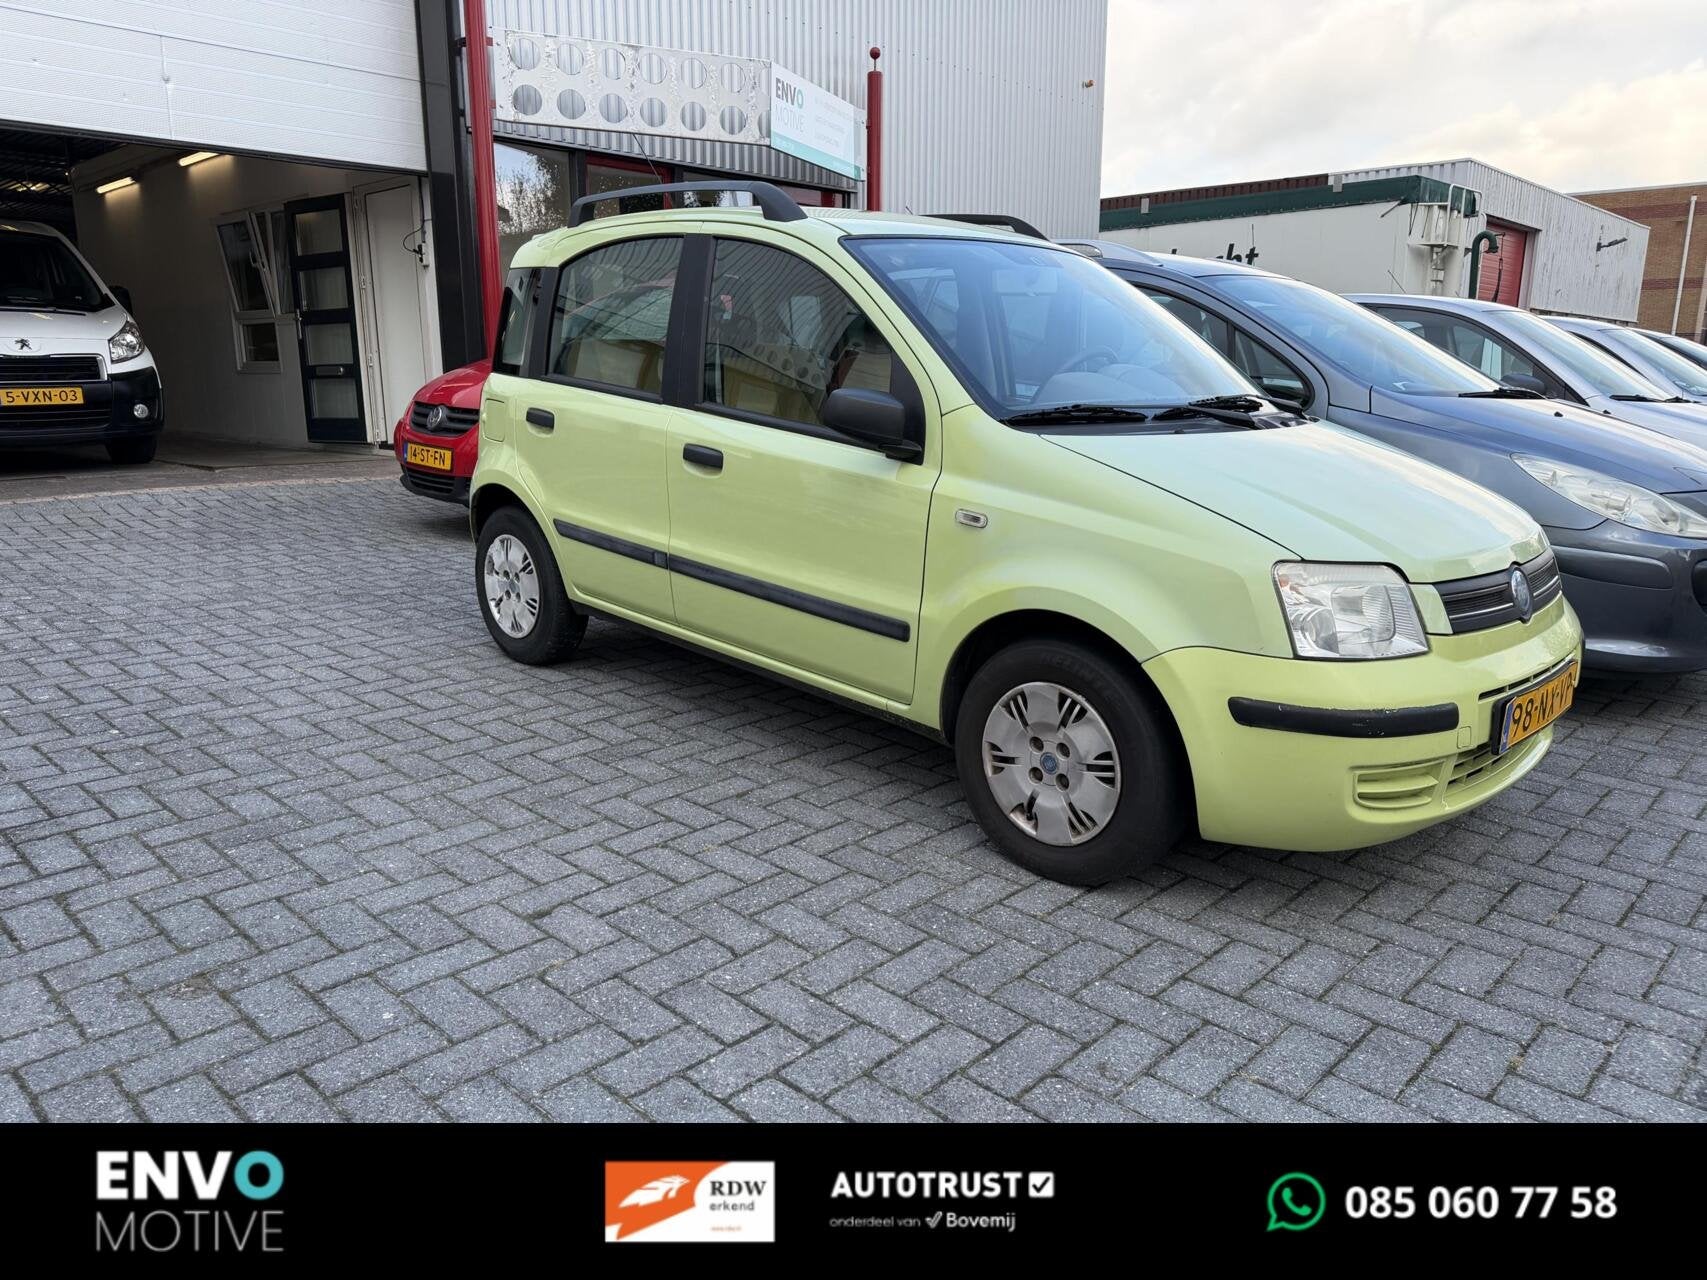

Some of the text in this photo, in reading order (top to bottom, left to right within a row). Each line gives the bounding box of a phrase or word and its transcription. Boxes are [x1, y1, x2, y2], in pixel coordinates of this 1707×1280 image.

[775, 77, 804, 109] ENVO
[775, 102, 805, 134] MOTIVE
[5, 389, 79, 404] 5-VXN-03
[411, 445, 446, 468] 14-ST-FN
